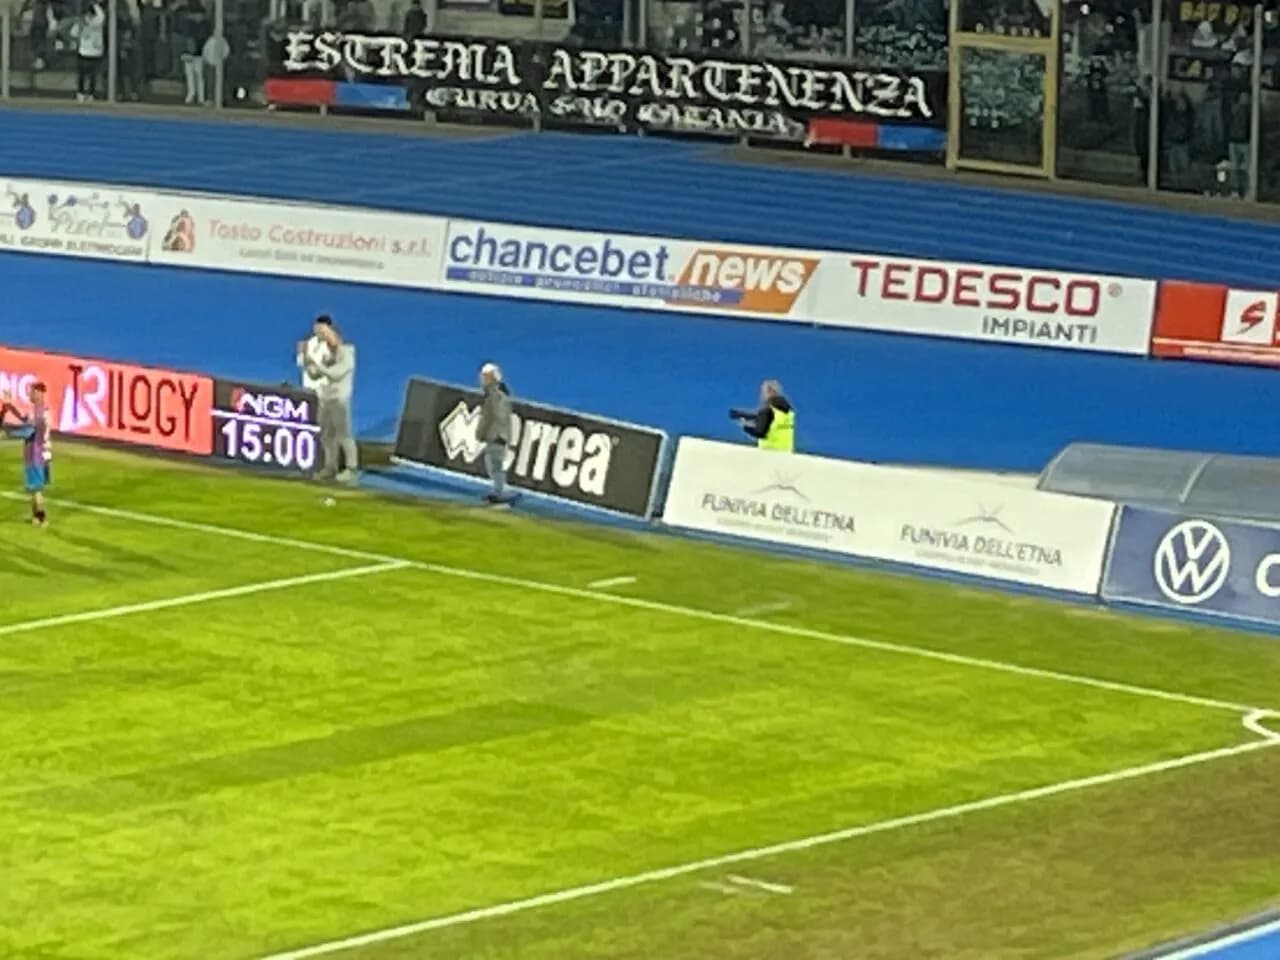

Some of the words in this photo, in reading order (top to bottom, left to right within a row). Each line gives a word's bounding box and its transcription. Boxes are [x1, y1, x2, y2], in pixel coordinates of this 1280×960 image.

[283, 31, 521, 86] ESTREMA
[543, 49, 933, 118] APPARTENENZA
[450, 227, 669, 281] chancebet
[692, 251, 806, 294] news
[851, 260, 1101, 317] TEDESCO
[981, 315, 1098, 344] IMPIANTI
[59, 363, 198, 442] TRILOGY
[238, 392, 309, 421] NGM
[222, 418, 315, 470] 15:00
[701, 493, 766, 517] FUNIVIA
[901, 524, 968, 552] FUNIVIA
